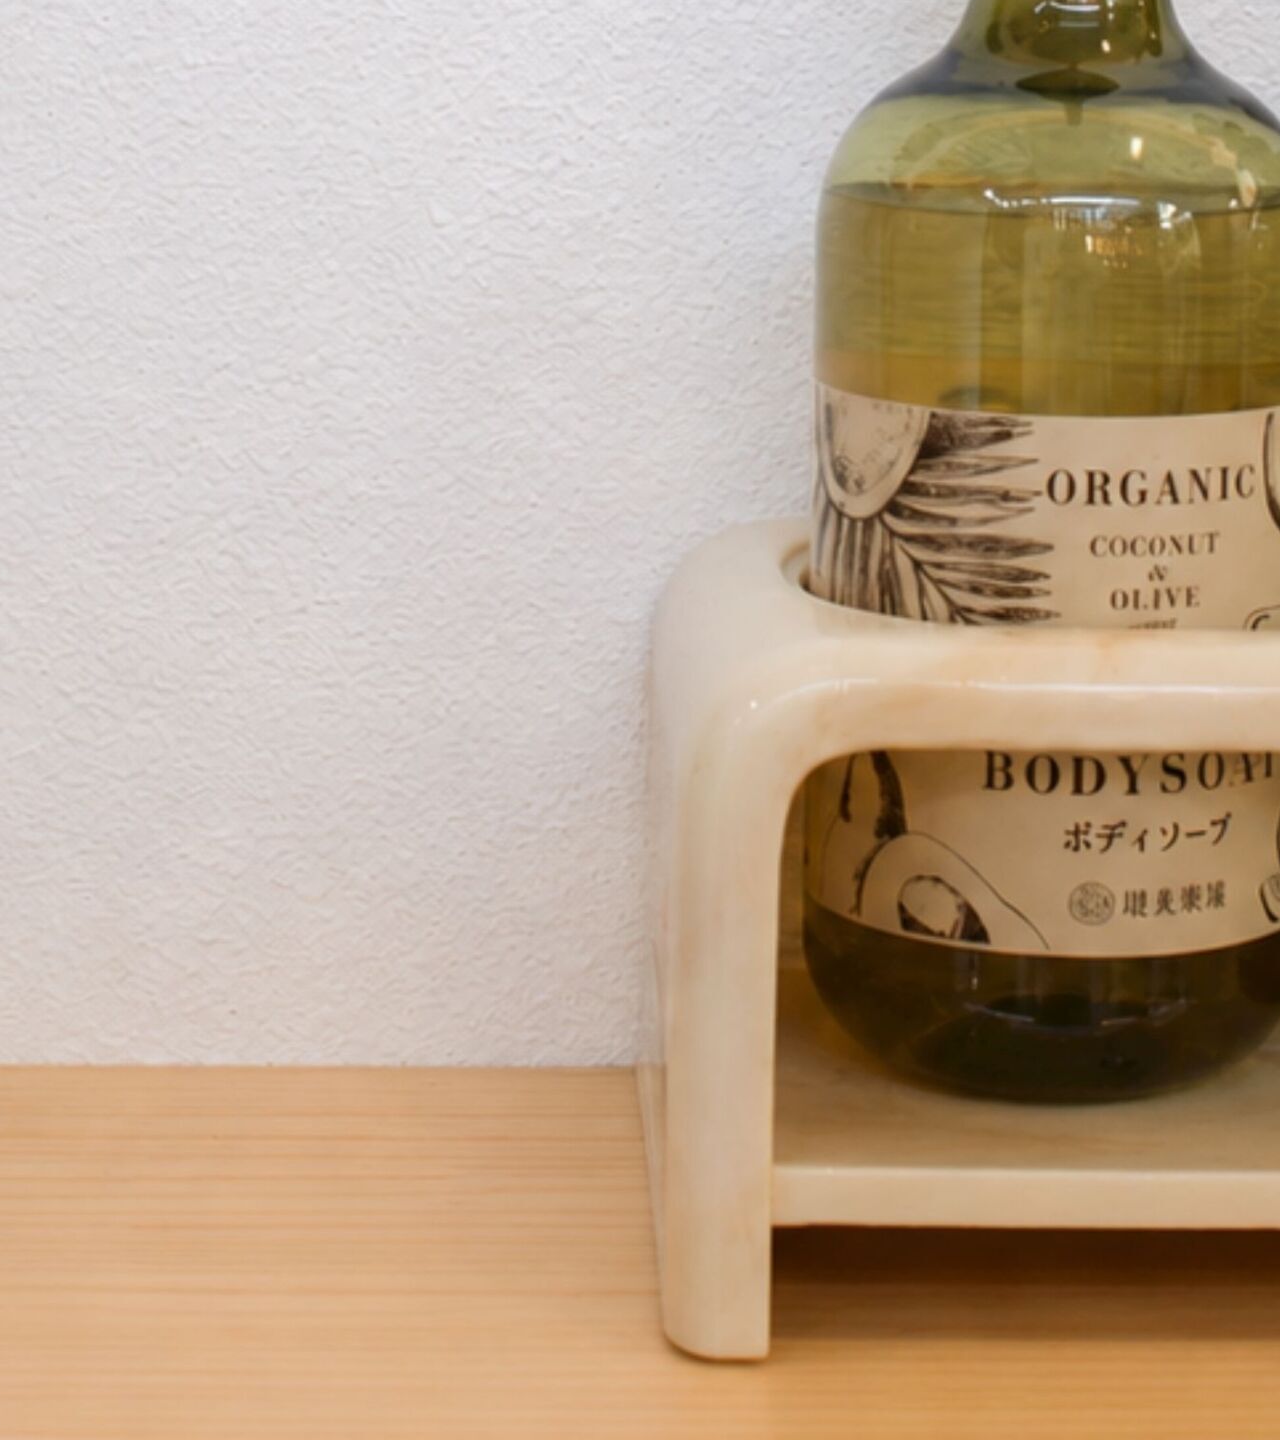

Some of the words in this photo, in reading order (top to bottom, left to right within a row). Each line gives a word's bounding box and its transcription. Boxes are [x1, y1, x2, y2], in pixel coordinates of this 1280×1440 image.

[1046, 464, 1256, 508] ORGANIC
[1089, 531, 1221, 557] COCONUT
[1110, 586, 1200, 611] OLIVE
[1063, 811, 1232, 853] ボディソープ
